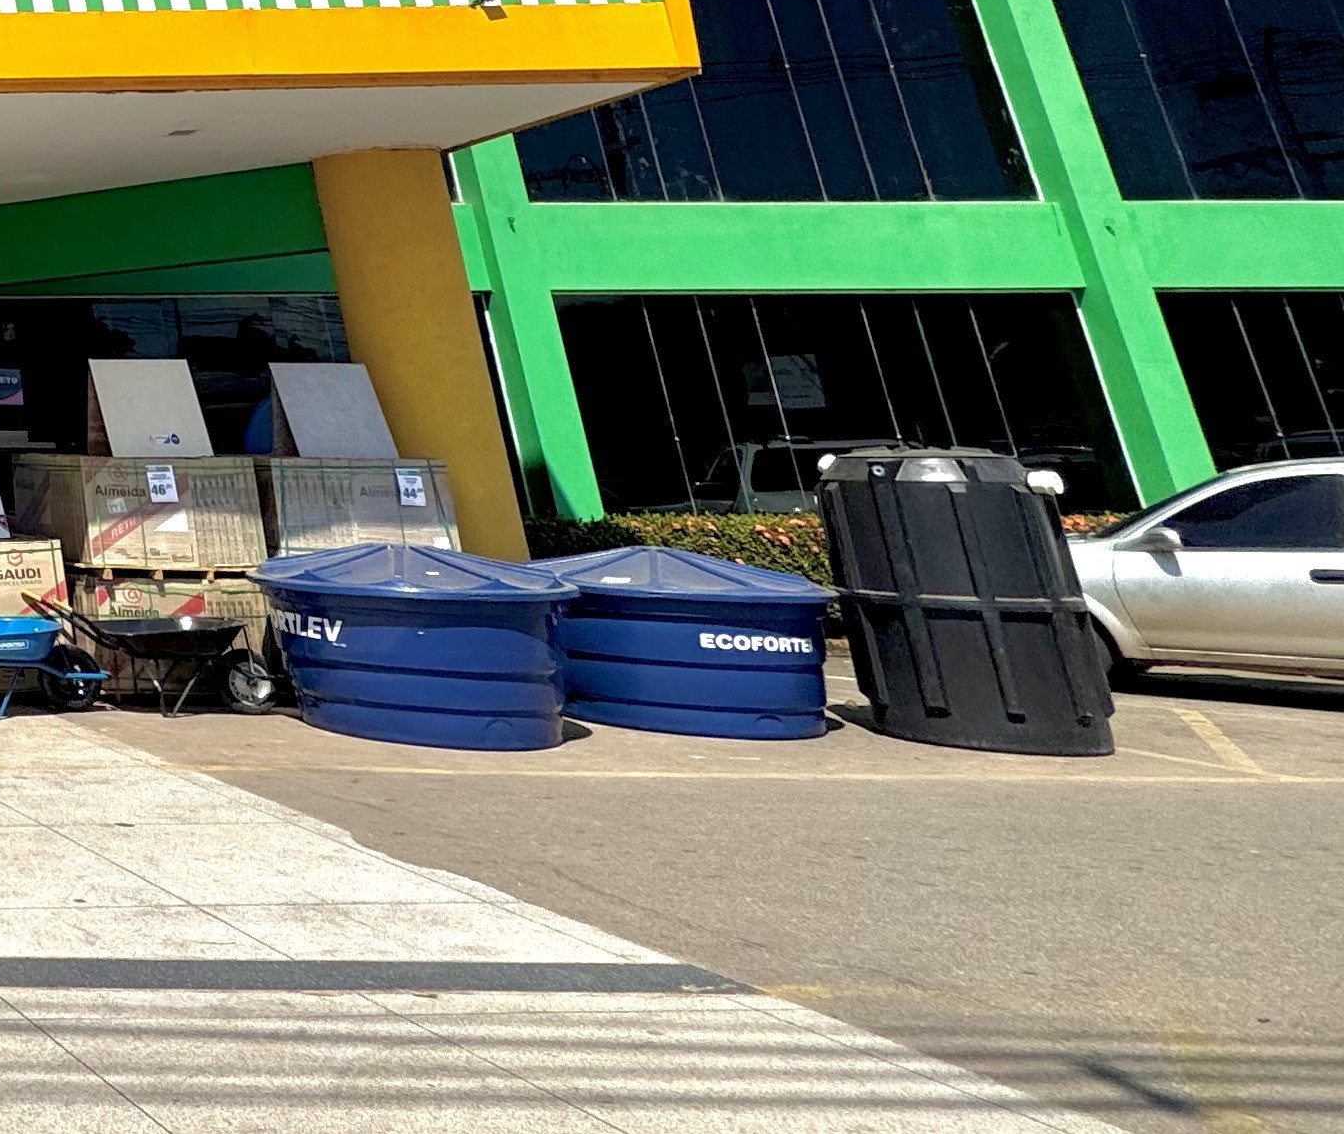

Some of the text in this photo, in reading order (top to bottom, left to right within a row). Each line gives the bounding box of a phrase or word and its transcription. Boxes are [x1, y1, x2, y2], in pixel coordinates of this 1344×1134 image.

[96, 484, 147, 498] Almeida
[271, 607, 344, 643] ORTLEV
[699, 632, 813, 654] ECOFORTE
